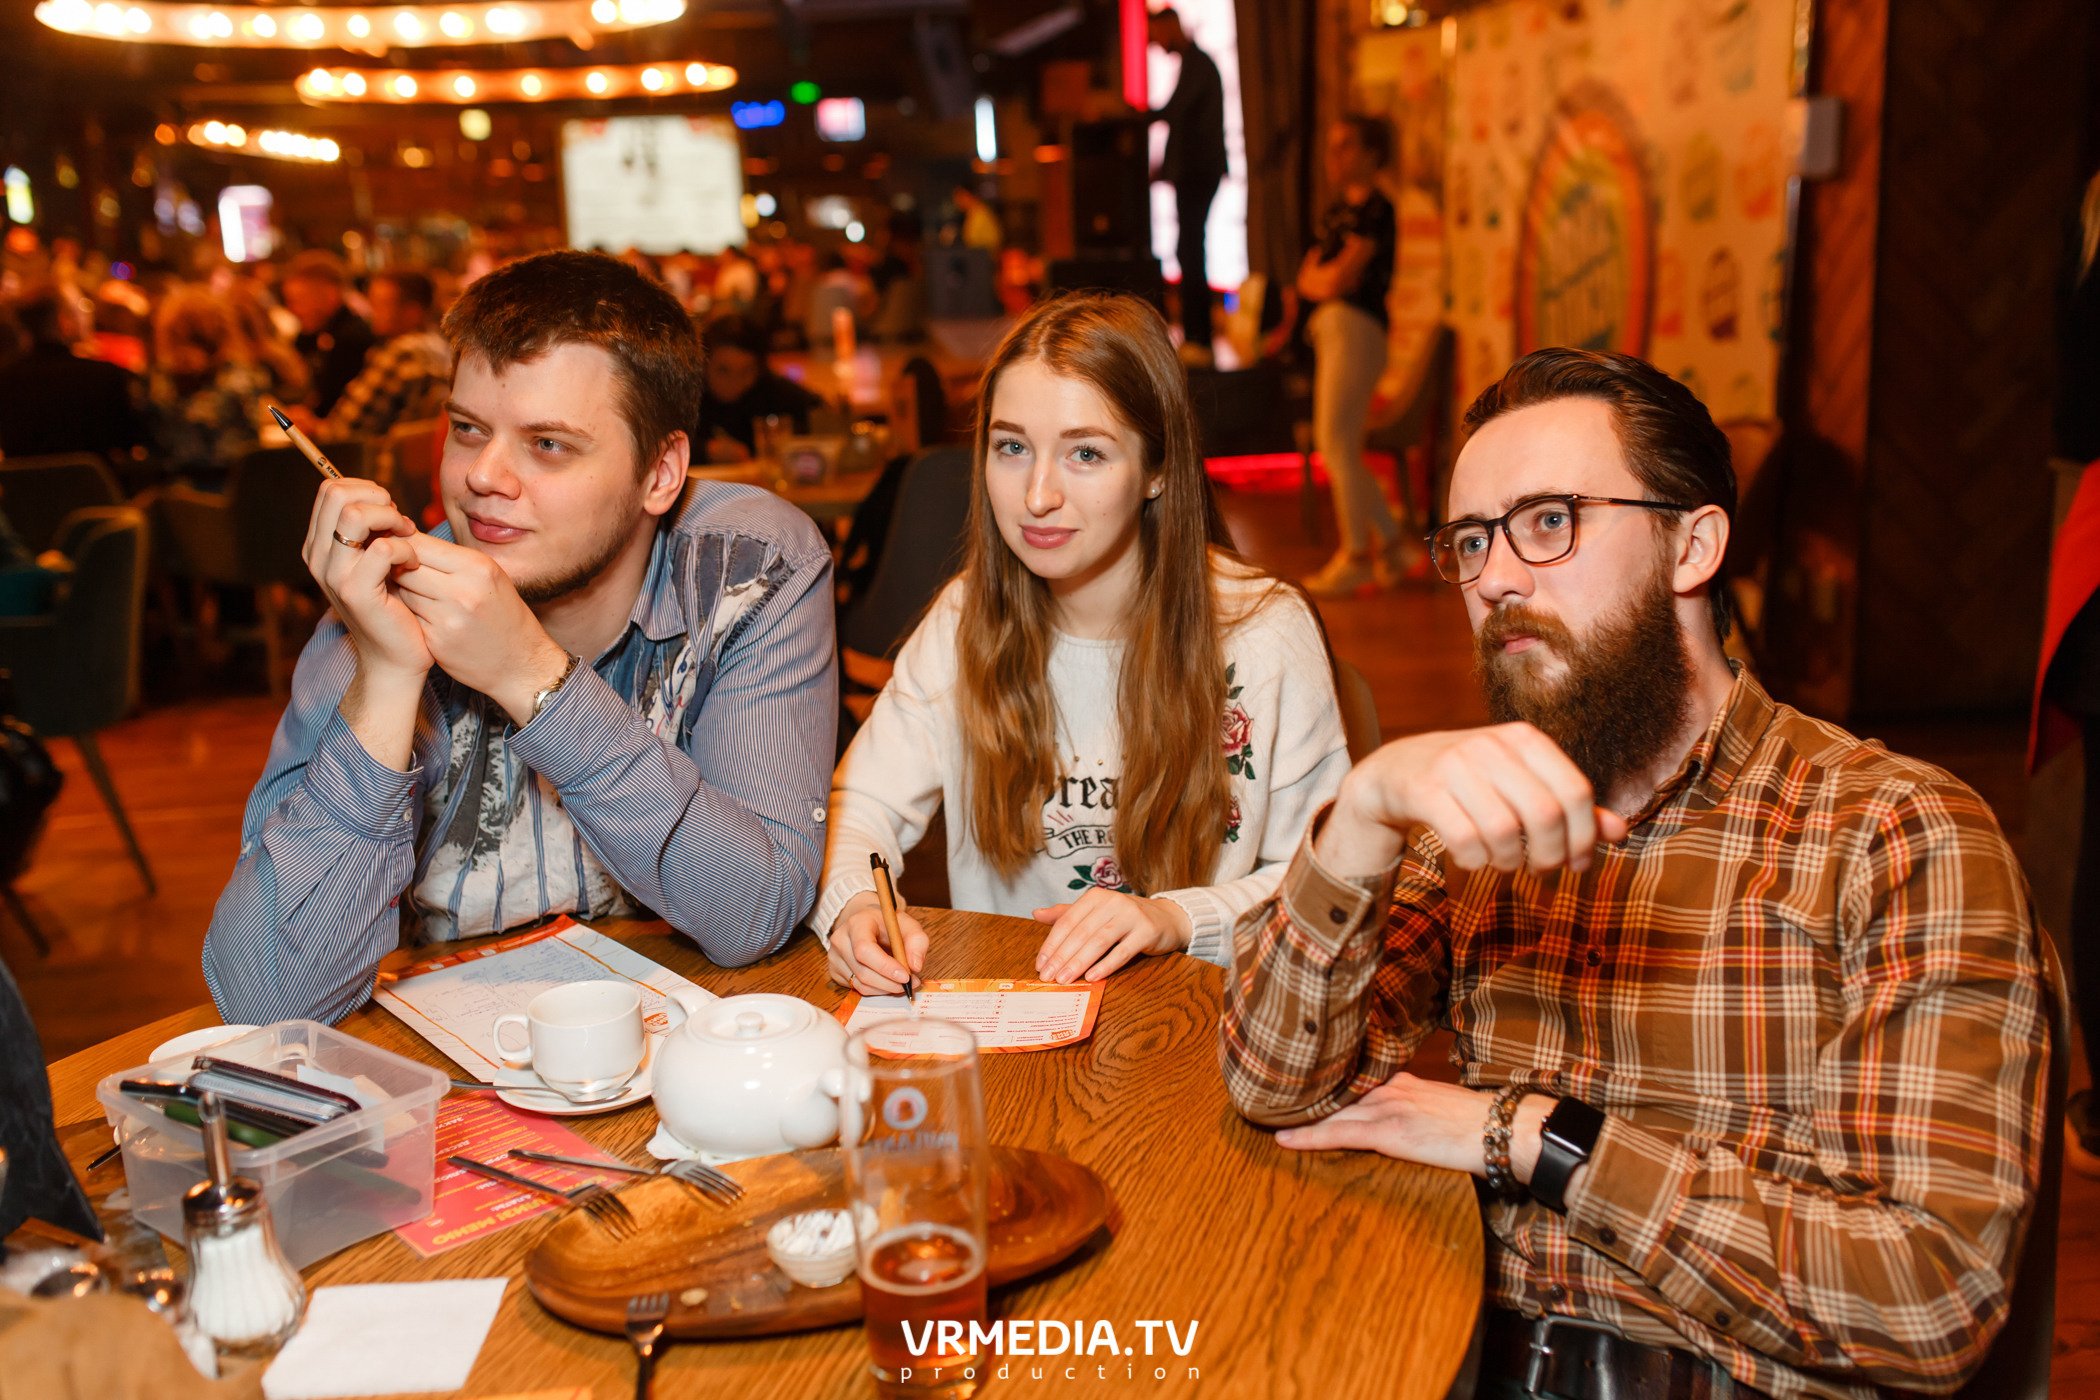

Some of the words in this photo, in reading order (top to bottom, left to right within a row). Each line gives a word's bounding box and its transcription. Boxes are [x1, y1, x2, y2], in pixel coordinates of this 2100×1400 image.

[1044, 776, 1120, 810] rea
[1059, 829, 1093, 849] THE
[431, 1218, 496, 1246] МЕНЮ
